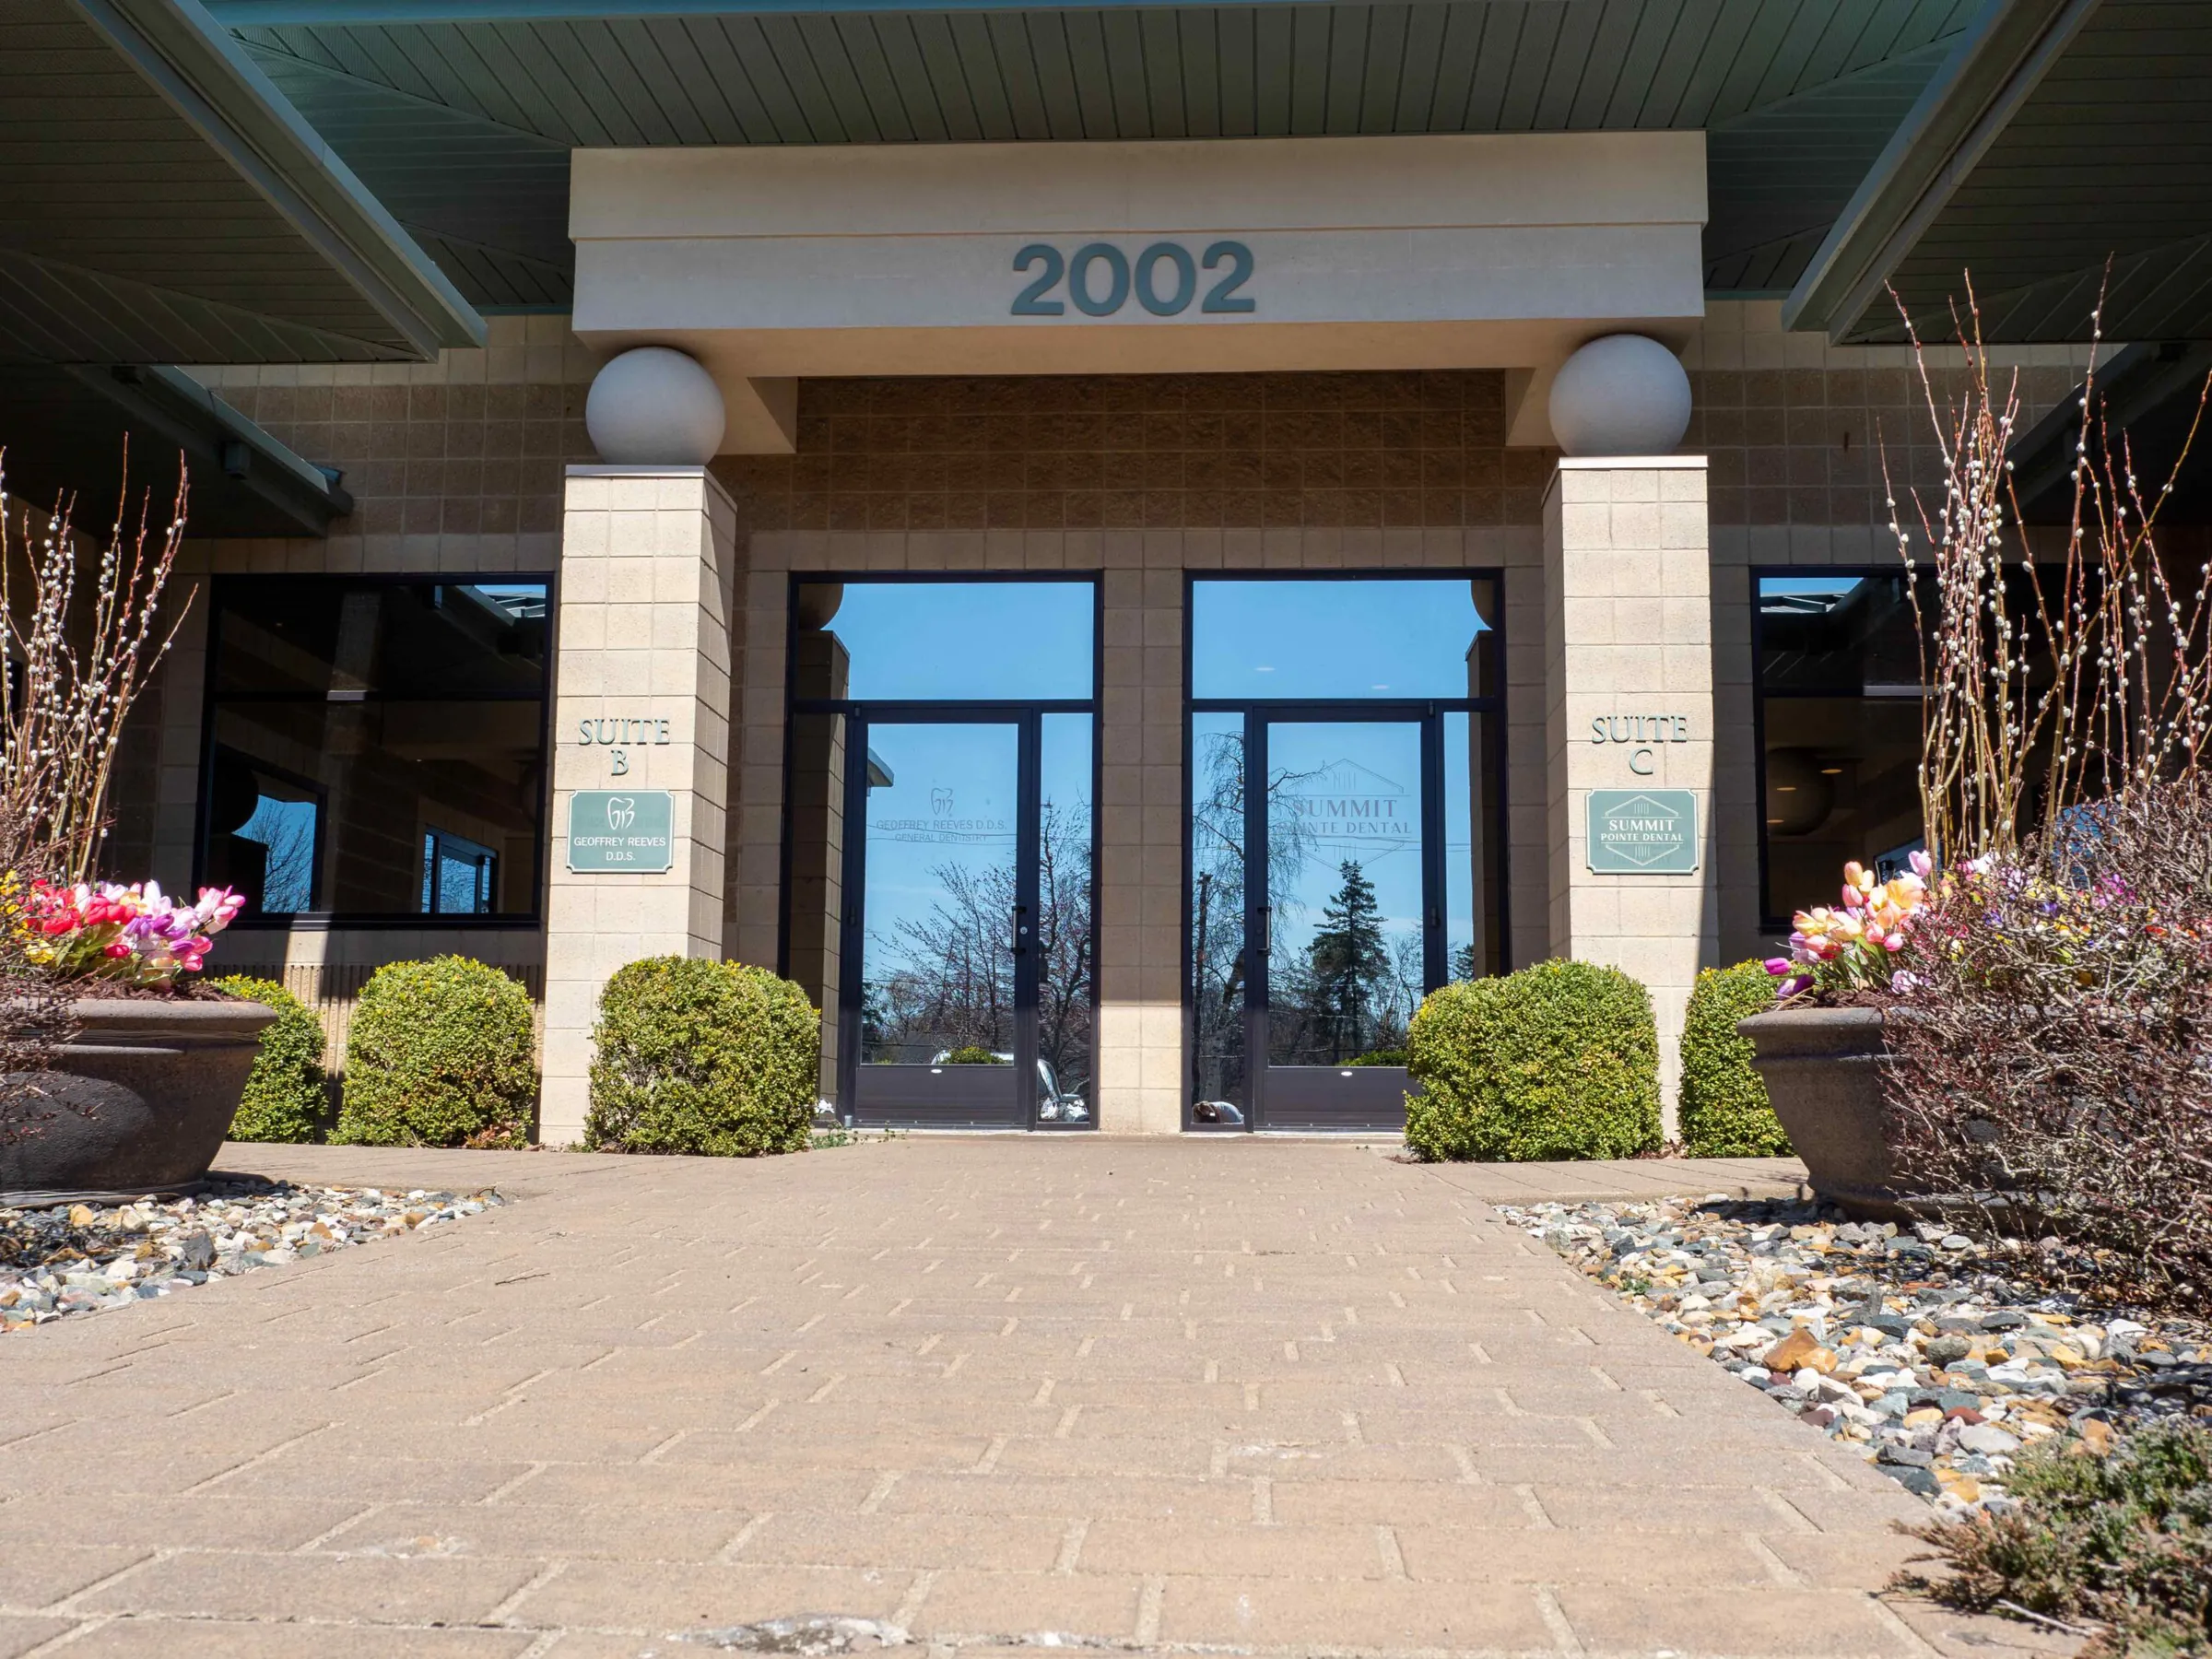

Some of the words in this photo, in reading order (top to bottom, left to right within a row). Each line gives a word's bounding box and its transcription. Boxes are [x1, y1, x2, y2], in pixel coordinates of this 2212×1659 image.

[1011, 241, 1255, 316] 2002
[578, 718, 670, 745] SUITE
[1592, 715, 1688, 744] SUITE
[611, 749, 629, 776] B
[1630, 748, 1653, 775] C
[1292, 799, 1397, 818] SUMMIT
[877, 819, 929, 830] GEOFFREY
[933, 819, 973, 830] REEVES
[976, 819, 1006, 830] D.D.S.
[1347, 821, 1412, 834] DENTAL
[1609, 819, 1675, 831] SUMMIT
[574, 837, 624, 846] GEOFFREY
[628, 837, 666, 846] REEVES
[895, 833, 935, 841] GENERAL
[939, 833, 987, 841] DENTISTRY
[1601, 832, 1639, 841] POINTE
[1642, 832, 1684, 841] DENTAL
[606, 852, 636, 861] D.D.S.
